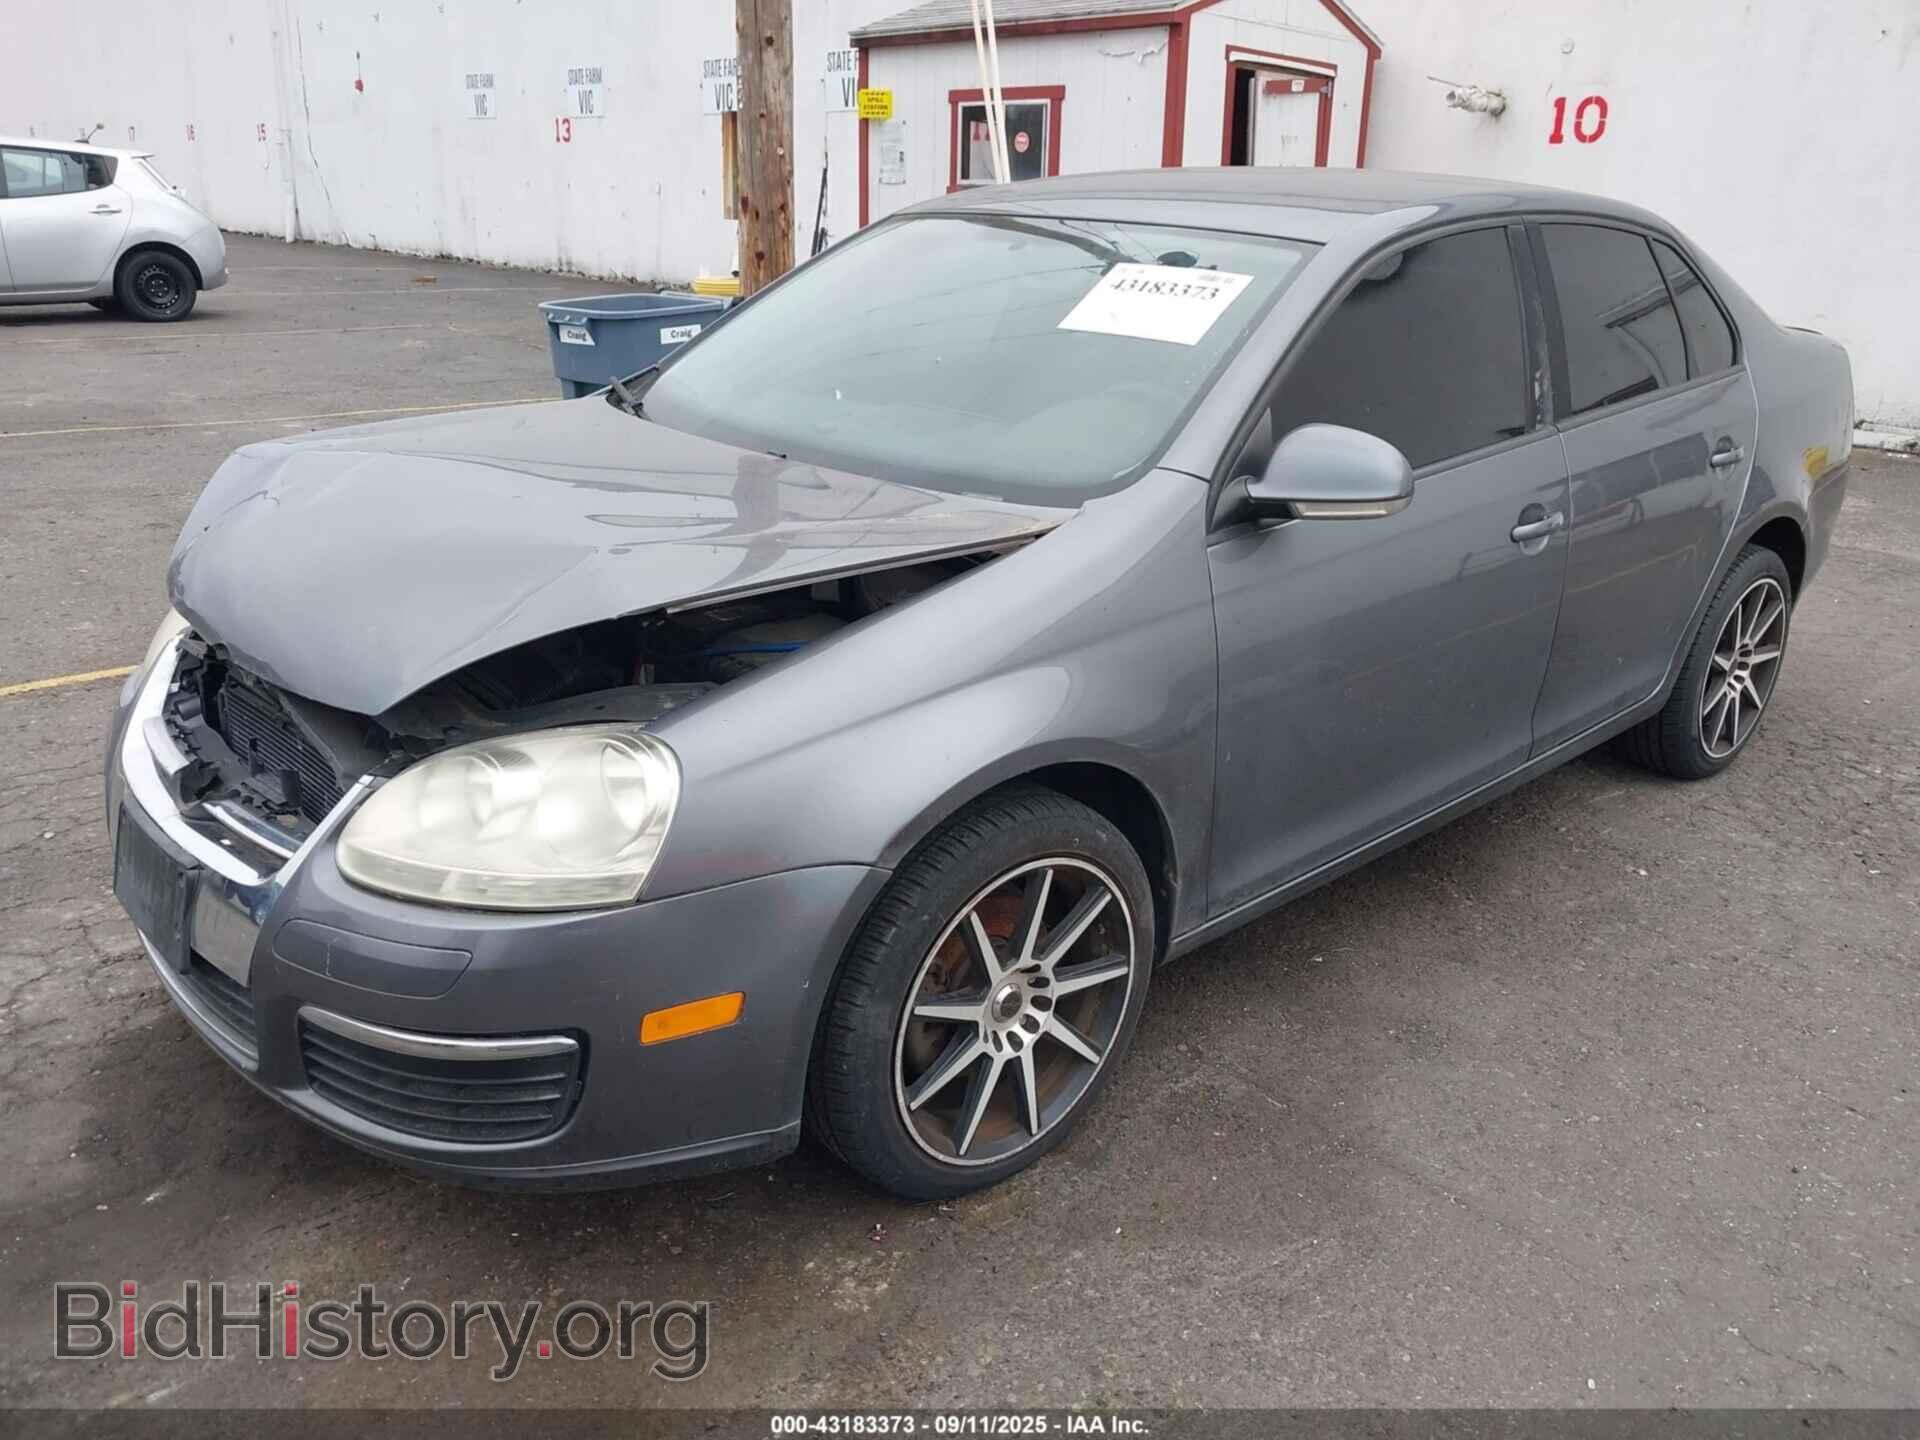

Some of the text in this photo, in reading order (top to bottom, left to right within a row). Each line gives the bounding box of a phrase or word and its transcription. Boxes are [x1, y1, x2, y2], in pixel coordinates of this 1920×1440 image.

[704, 57, 737, 79] STATE FAR
[826, 50, 852, 72] STATE
[568, 67, 602, 85] STATE FARM
[578, 89, 593, 114] VIC
[714, 83, 733, 111] VIC
[841, 77, 856, 107] VI
[474, 94, 487, 116] VIC
[555, 117, 571, 143] 13
[1549, 96, 1609, 144] 10
[1110, 278, 1220, 301] 43183373
[567, 329, 586, 342] Craig
[670, 328, 692, 339] Craig
